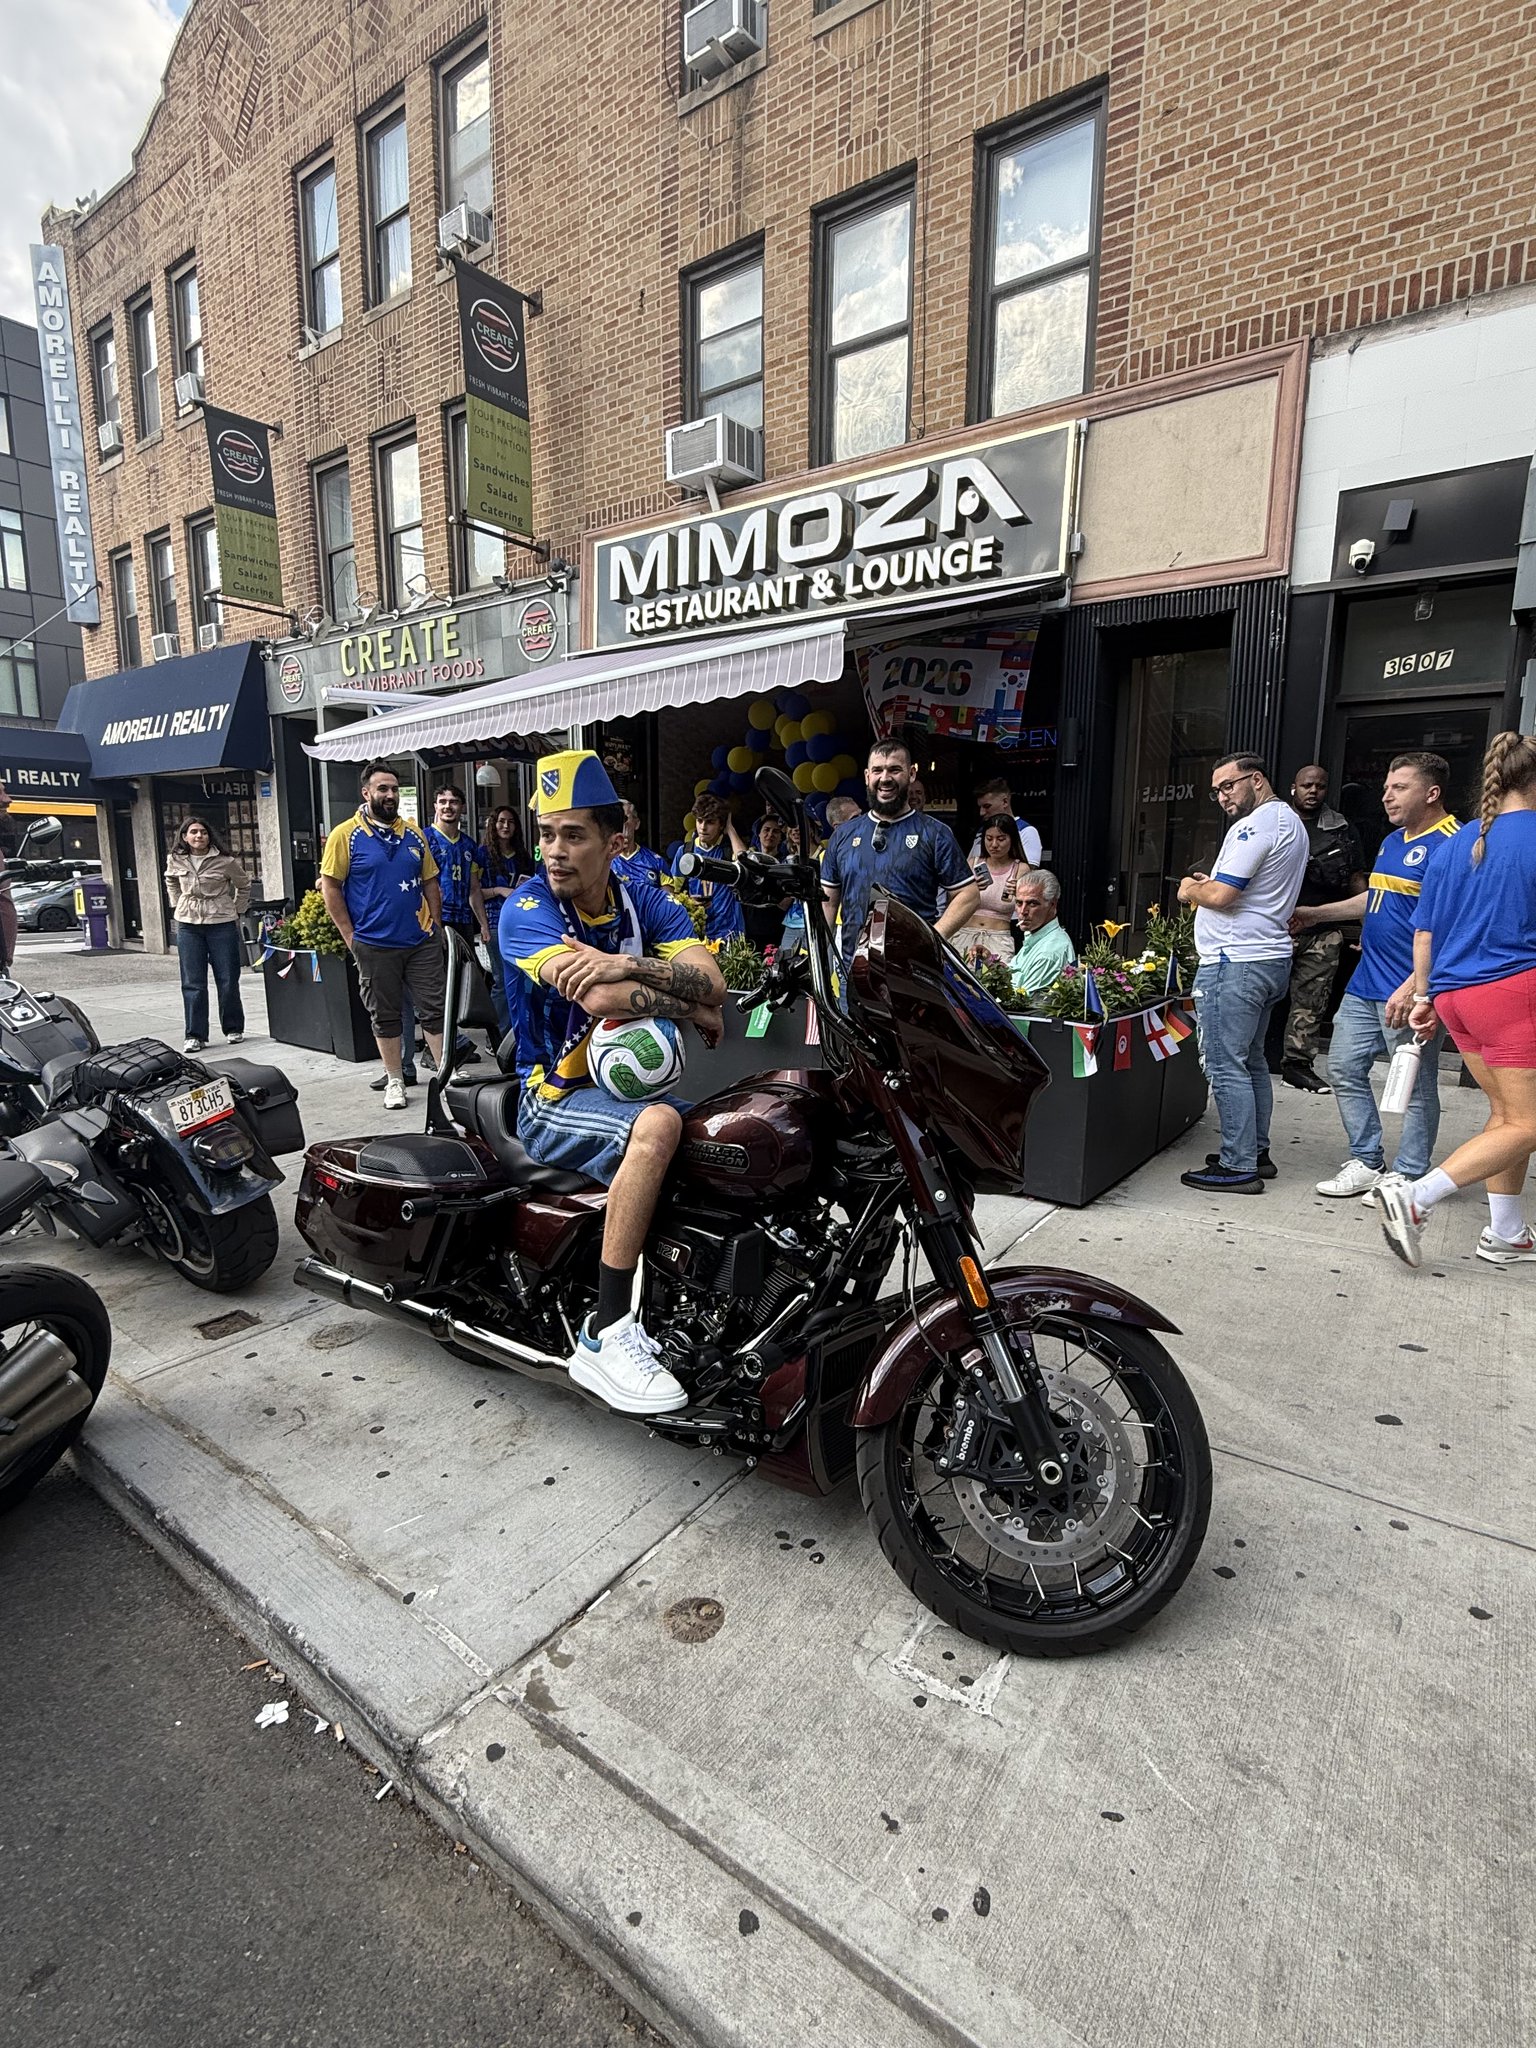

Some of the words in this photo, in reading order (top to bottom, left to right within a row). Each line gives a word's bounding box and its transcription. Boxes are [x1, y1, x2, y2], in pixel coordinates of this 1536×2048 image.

[476, 321, 514, 350] CREATE
[469, 374, 485, 390] FRESH
[486, 384, 509, 401] VIBRANT
[37, 261, 72, 449] AMORELLI
[59, 470, 90, 602] REALTY
[472, 406, 494, 421] YOUR
[496, 417, 529, 437] PREMIER
[474, 425, 528, 455] DESTINATION
[222, 447, 260, 466] CREATE
[473, 457, 530, 489] Sandwiches
[486, 482, 518, 503] Salads
[480, 501, 524, 528] Catering
[224, 525, 275, 544] DESTINATION
[610, 458, 1028, 602] MIMOZA
[224, 549, 279, 570] Sandwiches
[238, 567, 268, 581] Salads
[626, 574, 803, 634] RESTAURANT
[810, 568, 836, 600] &
[846, 535, 996, 595] LOUNGE
[232, 581, 274, 599] Catering
[521, 622, 553, 637] CREATE
[340, 614, 461, 677] CREATE
[367, 668, 427, 691] VIBRANT
[431, 658, 485, 683] FOODS
[882, 656, 973, 696] 2026
[1385, 651, 1453, 676] 3607
[100, 713, 169, 746] AMORELLI
[169, 703, 230, 737] REALTY
[17, 769, 80, 787] REALTY
[452, 864, 462, 881] 23
[179, 1090, 224, 1121] 873CH5
[656, 1240, 681, 1262] 121
[956, 1419, 975, 1461] brembo
